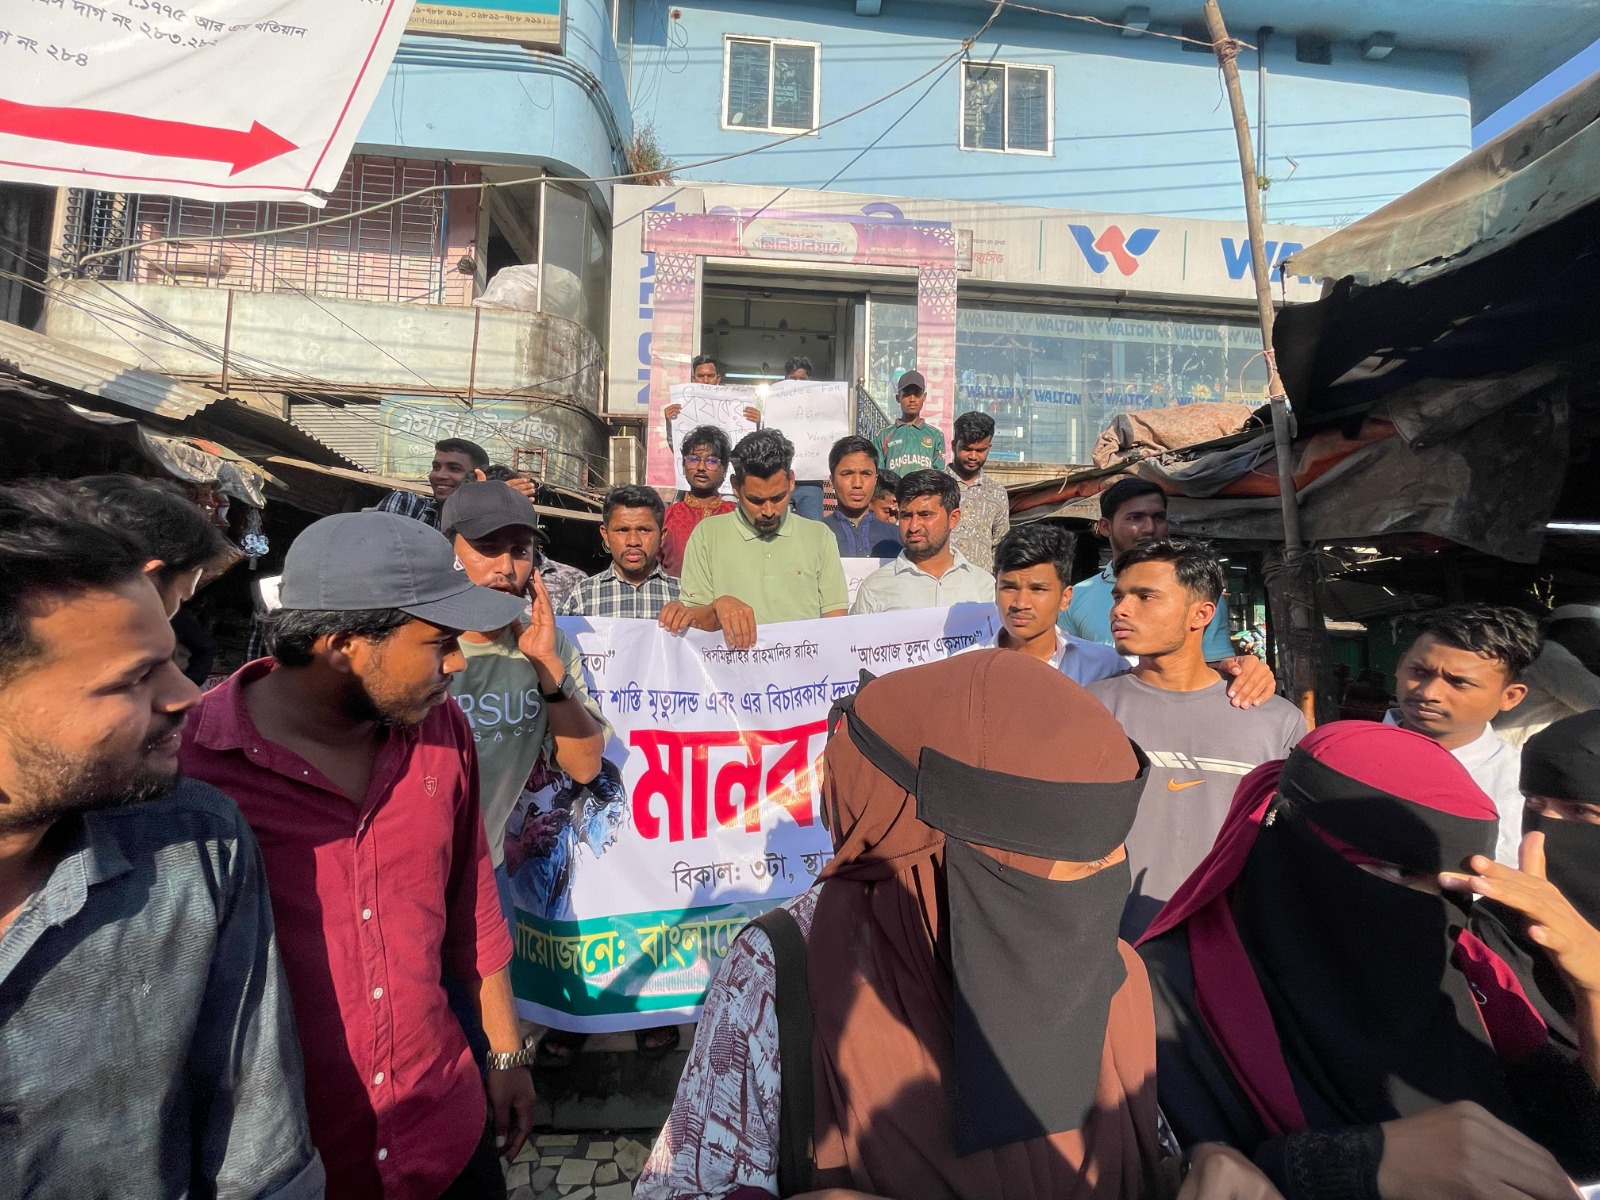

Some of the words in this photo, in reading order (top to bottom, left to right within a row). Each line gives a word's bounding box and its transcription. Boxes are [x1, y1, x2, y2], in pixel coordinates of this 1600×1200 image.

[72, 0, 107, 22] দাগ
[112, 12, 132, 32] নং
[194, 15, 226, 33] আর
[255, 20, 308, 38] খতিয়ান
[17, 35, 38, 54] নং
[47, 45, 88, 67] ২৮৪
[964, 311, 1015, 328] WALTON
[1035, 317, 1085, 333] WALTON
[1106, 321, 1154, 337] WALTON
[1175, 326, 1222, 341] WALTON
[1243, 331, 1262, 344] WA
[967, 385, 1015, 400] WALTON
[1034, 389, 1082, 405] WALTON
[580, 649, 616, 675] বতা”
[751, 642, 791, 664] রাহমানির
[793, 639, 819, 660] রাহিম
[904, 639, 931, 665] তুলুন
[453, 688, 541, 729] RSUS
[609, 681, 644, 714] শাস্তি
[705, 690, 738, 716] এবং
[740, 692, 762, 715] এর
[766, 675, 829, 714] বিচারকার্য
[637, 914, 751, 968] বাংলাদে
